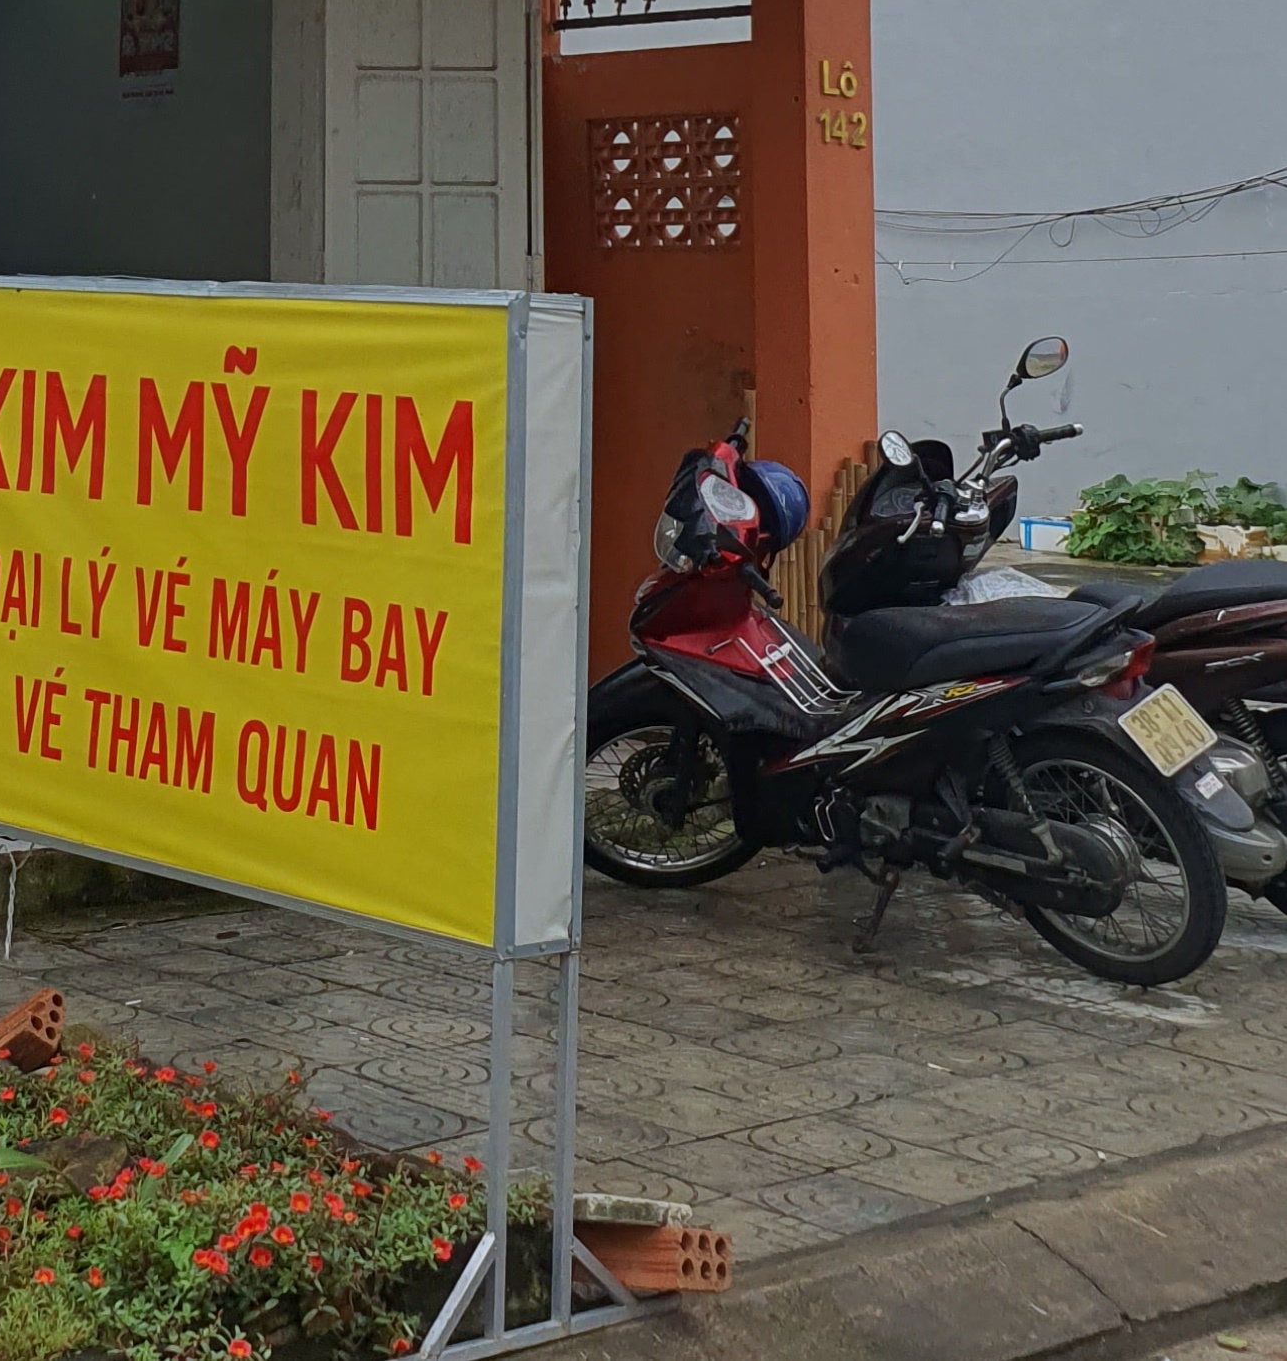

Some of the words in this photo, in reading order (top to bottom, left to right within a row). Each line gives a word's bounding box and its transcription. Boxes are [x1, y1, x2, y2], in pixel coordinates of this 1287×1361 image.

[818, 108, 867, 148] 142
[820, 59, 859, 98] Lô
[136, 345, 271, 518] MỸ
[300, 388, 474, 546] KIM
[59, 546, 117, 639] LÝ
[134, 556, 188, 654] VÉ
[208, 569, 321, 674] MÁY
[340, 596, 449, 697] BAY
[15, 667, 68, 762] VÉ
[83, 688, 216, 795] THAM
[235, 719, 382, 832] QUAN
